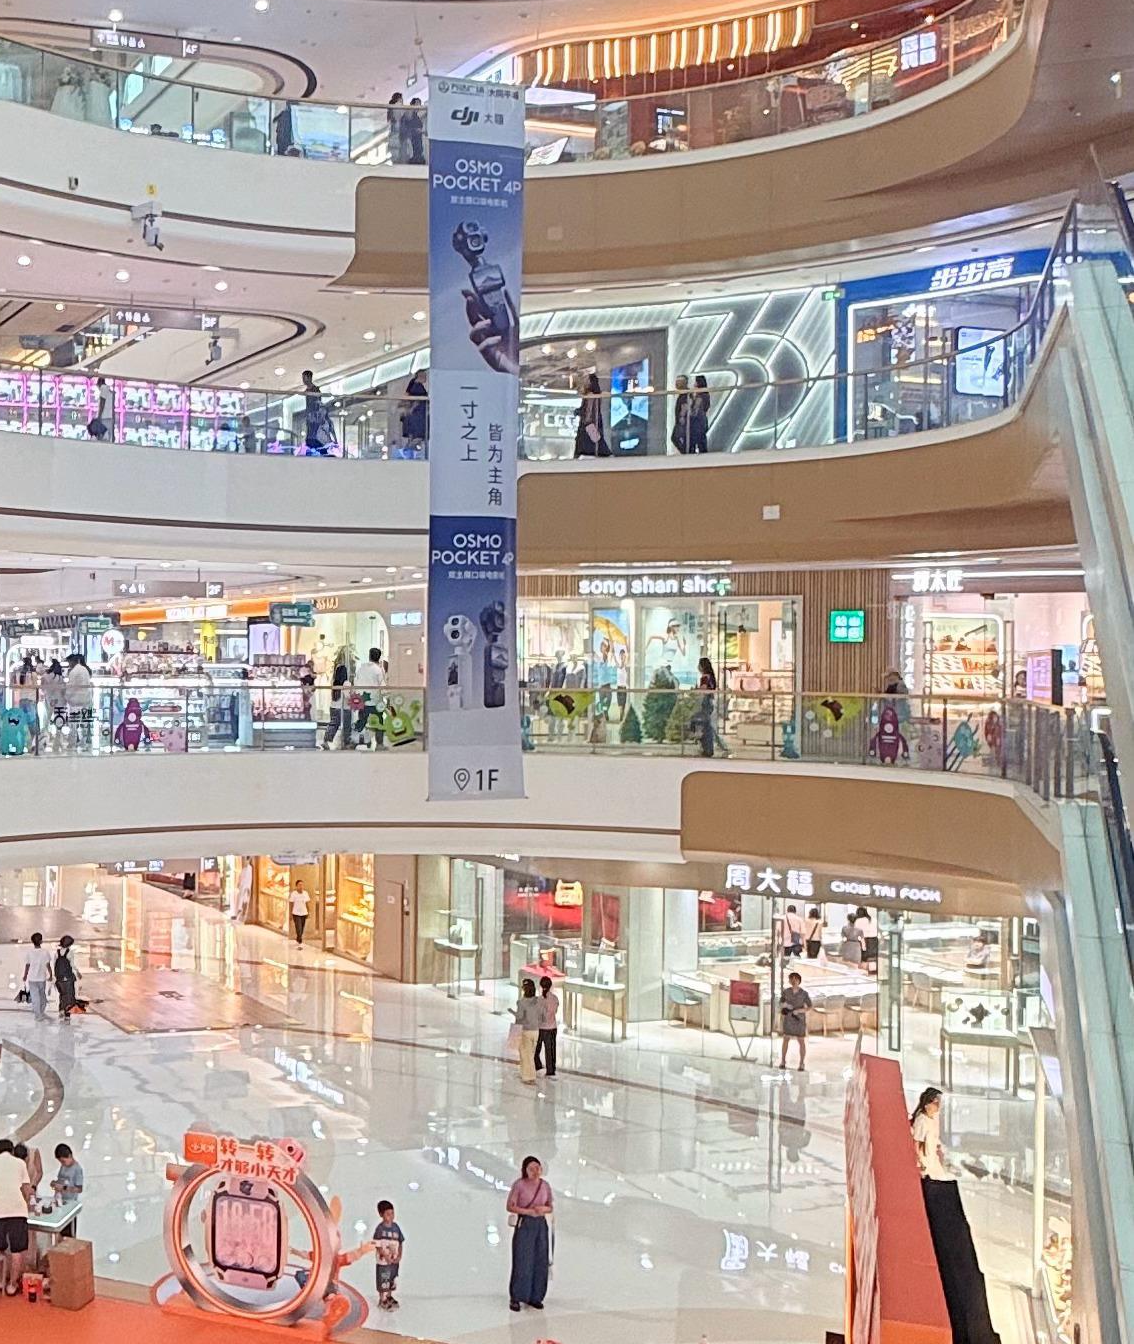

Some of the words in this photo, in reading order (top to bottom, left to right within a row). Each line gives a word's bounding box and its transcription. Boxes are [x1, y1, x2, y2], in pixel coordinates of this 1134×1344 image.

[455, 158, 503, 176] OSMO
[432, 173, 501, 193] POCKET
[503, 180, 522, 194] 4P
[929, 256, 1015, 291] 步步高
[204, 316, 217, 328] 3F
[460, 385, 479, 462] 一寸之上
[487, 423, 503, 506] 皆为主角
[453, 533, 502, 549] OSMO
[432, 550, 499, 566] POCKET
[208, 582, 221, 595] 2F
[578, 578, 627, 597] song
[631, 575, 678, 594] shan
[682, 574, 730, 594] sho
[476, 768, 499, 791] 1F
[725, 863, 814, 896] 周大福
[830, 880, 870, 896] CHOW
[872, 884, 896, 898] TAI
[899, 886, 942, 903] FOOK
[220, 1139, 275, 1162] 转一转
[220, 1158, 297, 1184] 才够小天才
